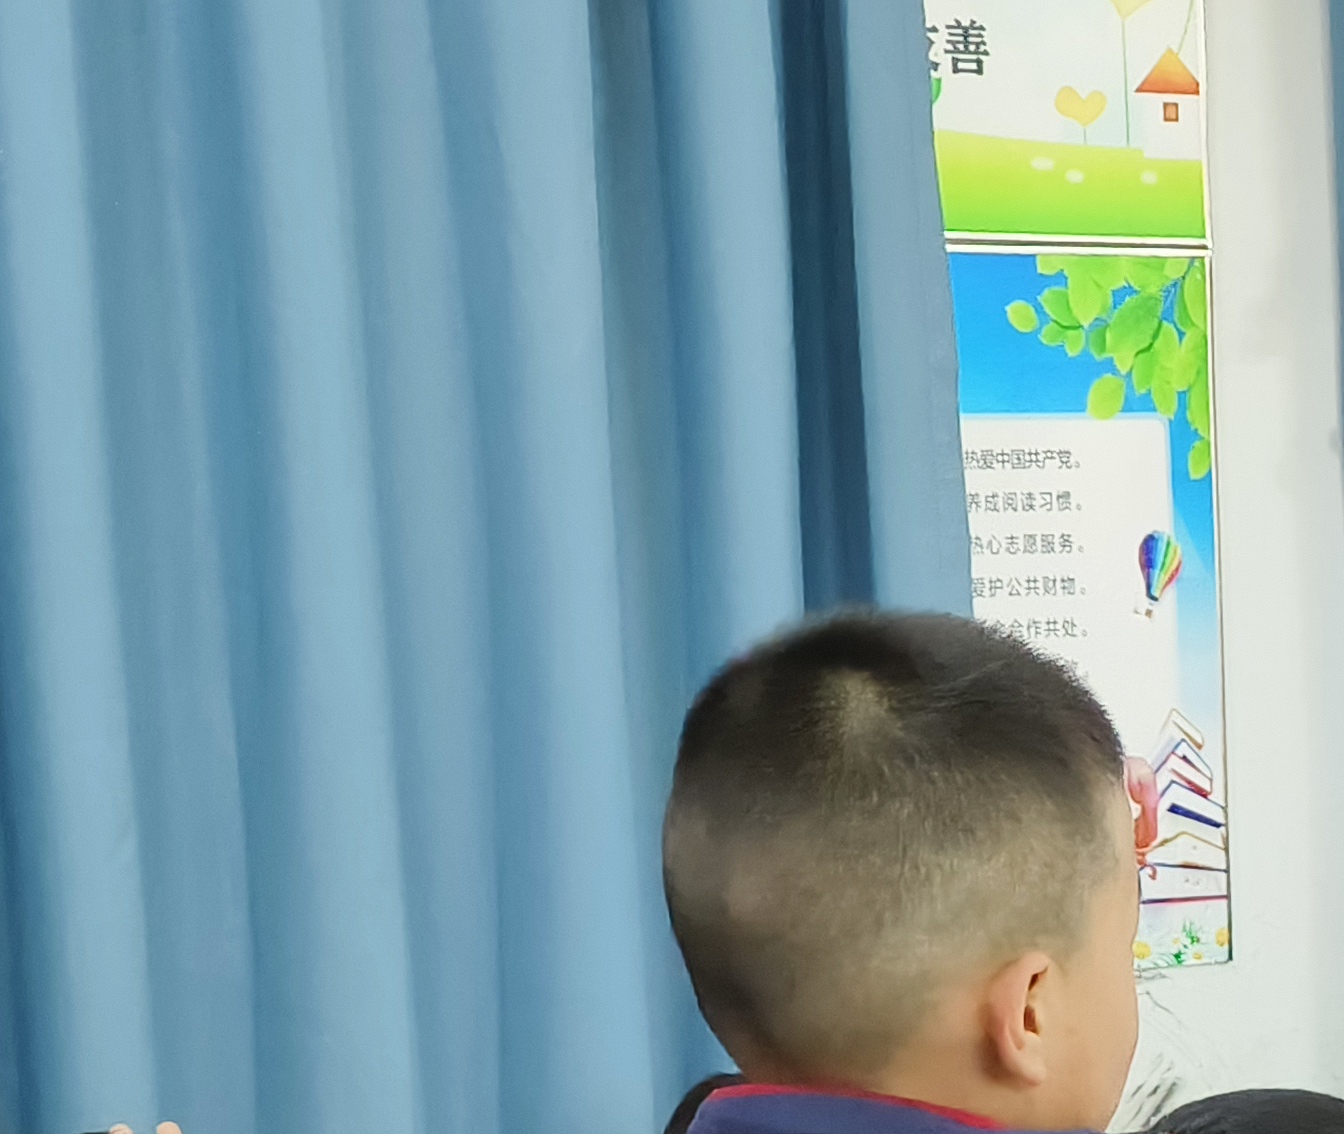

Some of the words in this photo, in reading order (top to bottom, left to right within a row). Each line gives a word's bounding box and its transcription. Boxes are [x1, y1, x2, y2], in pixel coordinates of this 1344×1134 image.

[964, 448, 1081, 470] 热爱中国共产党。
[966, 491, 1082, 513] 养成阅读习惯。
